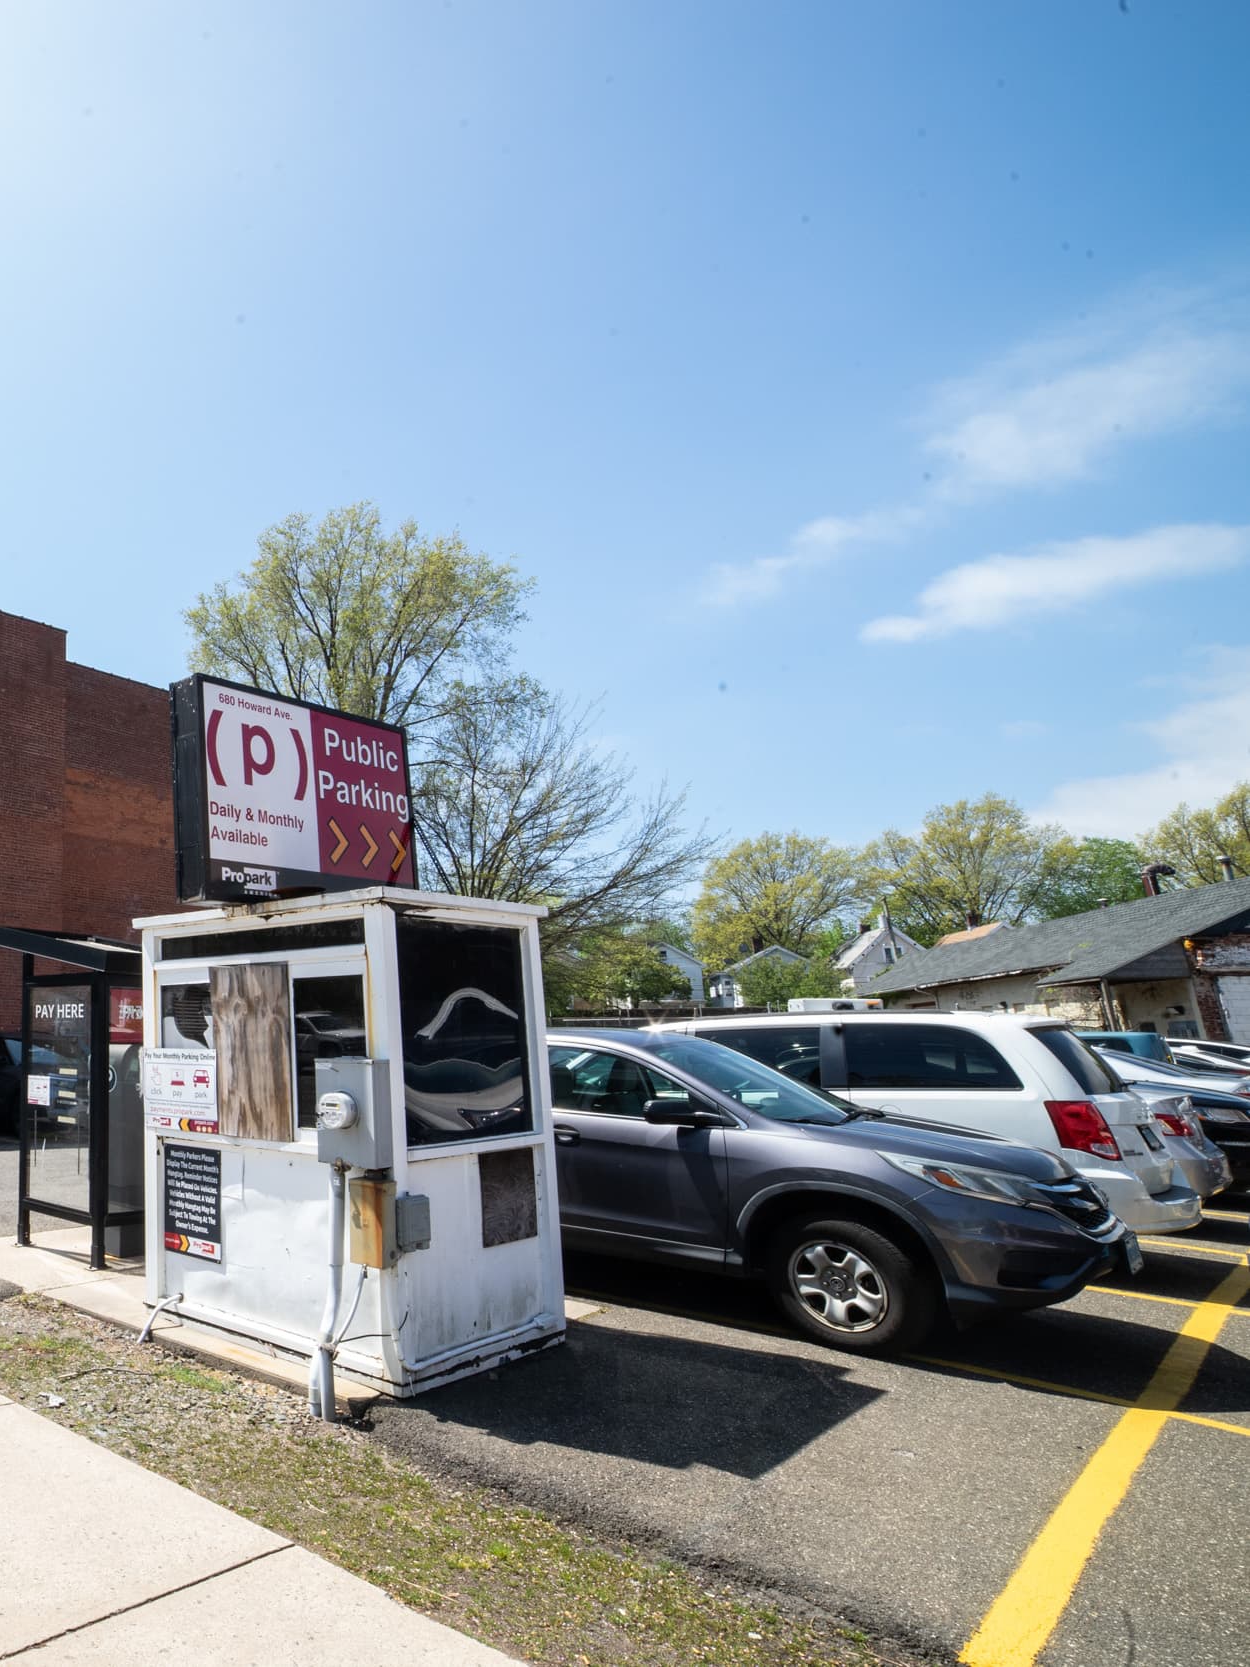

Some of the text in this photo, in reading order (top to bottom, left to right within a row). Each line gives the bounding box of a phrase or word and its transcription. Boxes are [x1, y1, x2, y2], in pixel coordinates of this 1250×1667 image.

[218, 692, 293, 721] 680 Howard Ave.
[324, 727, 399, 772] Public
[318, 769, 410, 825] Parking
[210, 801, 304, 832] Daily & Monthly
[210, 825, 268, 848] Available
[221, 866, 273, 887] Propark
[35, 1003, 84, 1019] PAY HERE
[162, 1052, 180, 1060] Monthly
[182, 1053, 199, 1062] Parking
[172, 1090, 182, 1098] pay
[194, 1090, 208, 1098] park
[170, 1150, 215, 1162] Monthly Parkers Please
[166, 1159, 180, 1168] Display
[188, 1162, 203, 1170] Current
[180, 1180, 194, 1190] Placed
[184, 1172, 202, 1181] Reminder
[202, 1174, 218, 1184] Notices
[169, 1189, 185, 1198] Vehicles
[186, 1192, 201, 1202] Without
[205, 1196, 216, 1204] Valid
[168, 1200, 216, 1215] Monthly Hangtag May Be
[168, 1208, 183, 1218] Subject
[188, 1212, 202, 1224] Towing
[208, 1216, 216, 1225] The
[176, 1220, 209, 1234] Owner's Expense.
